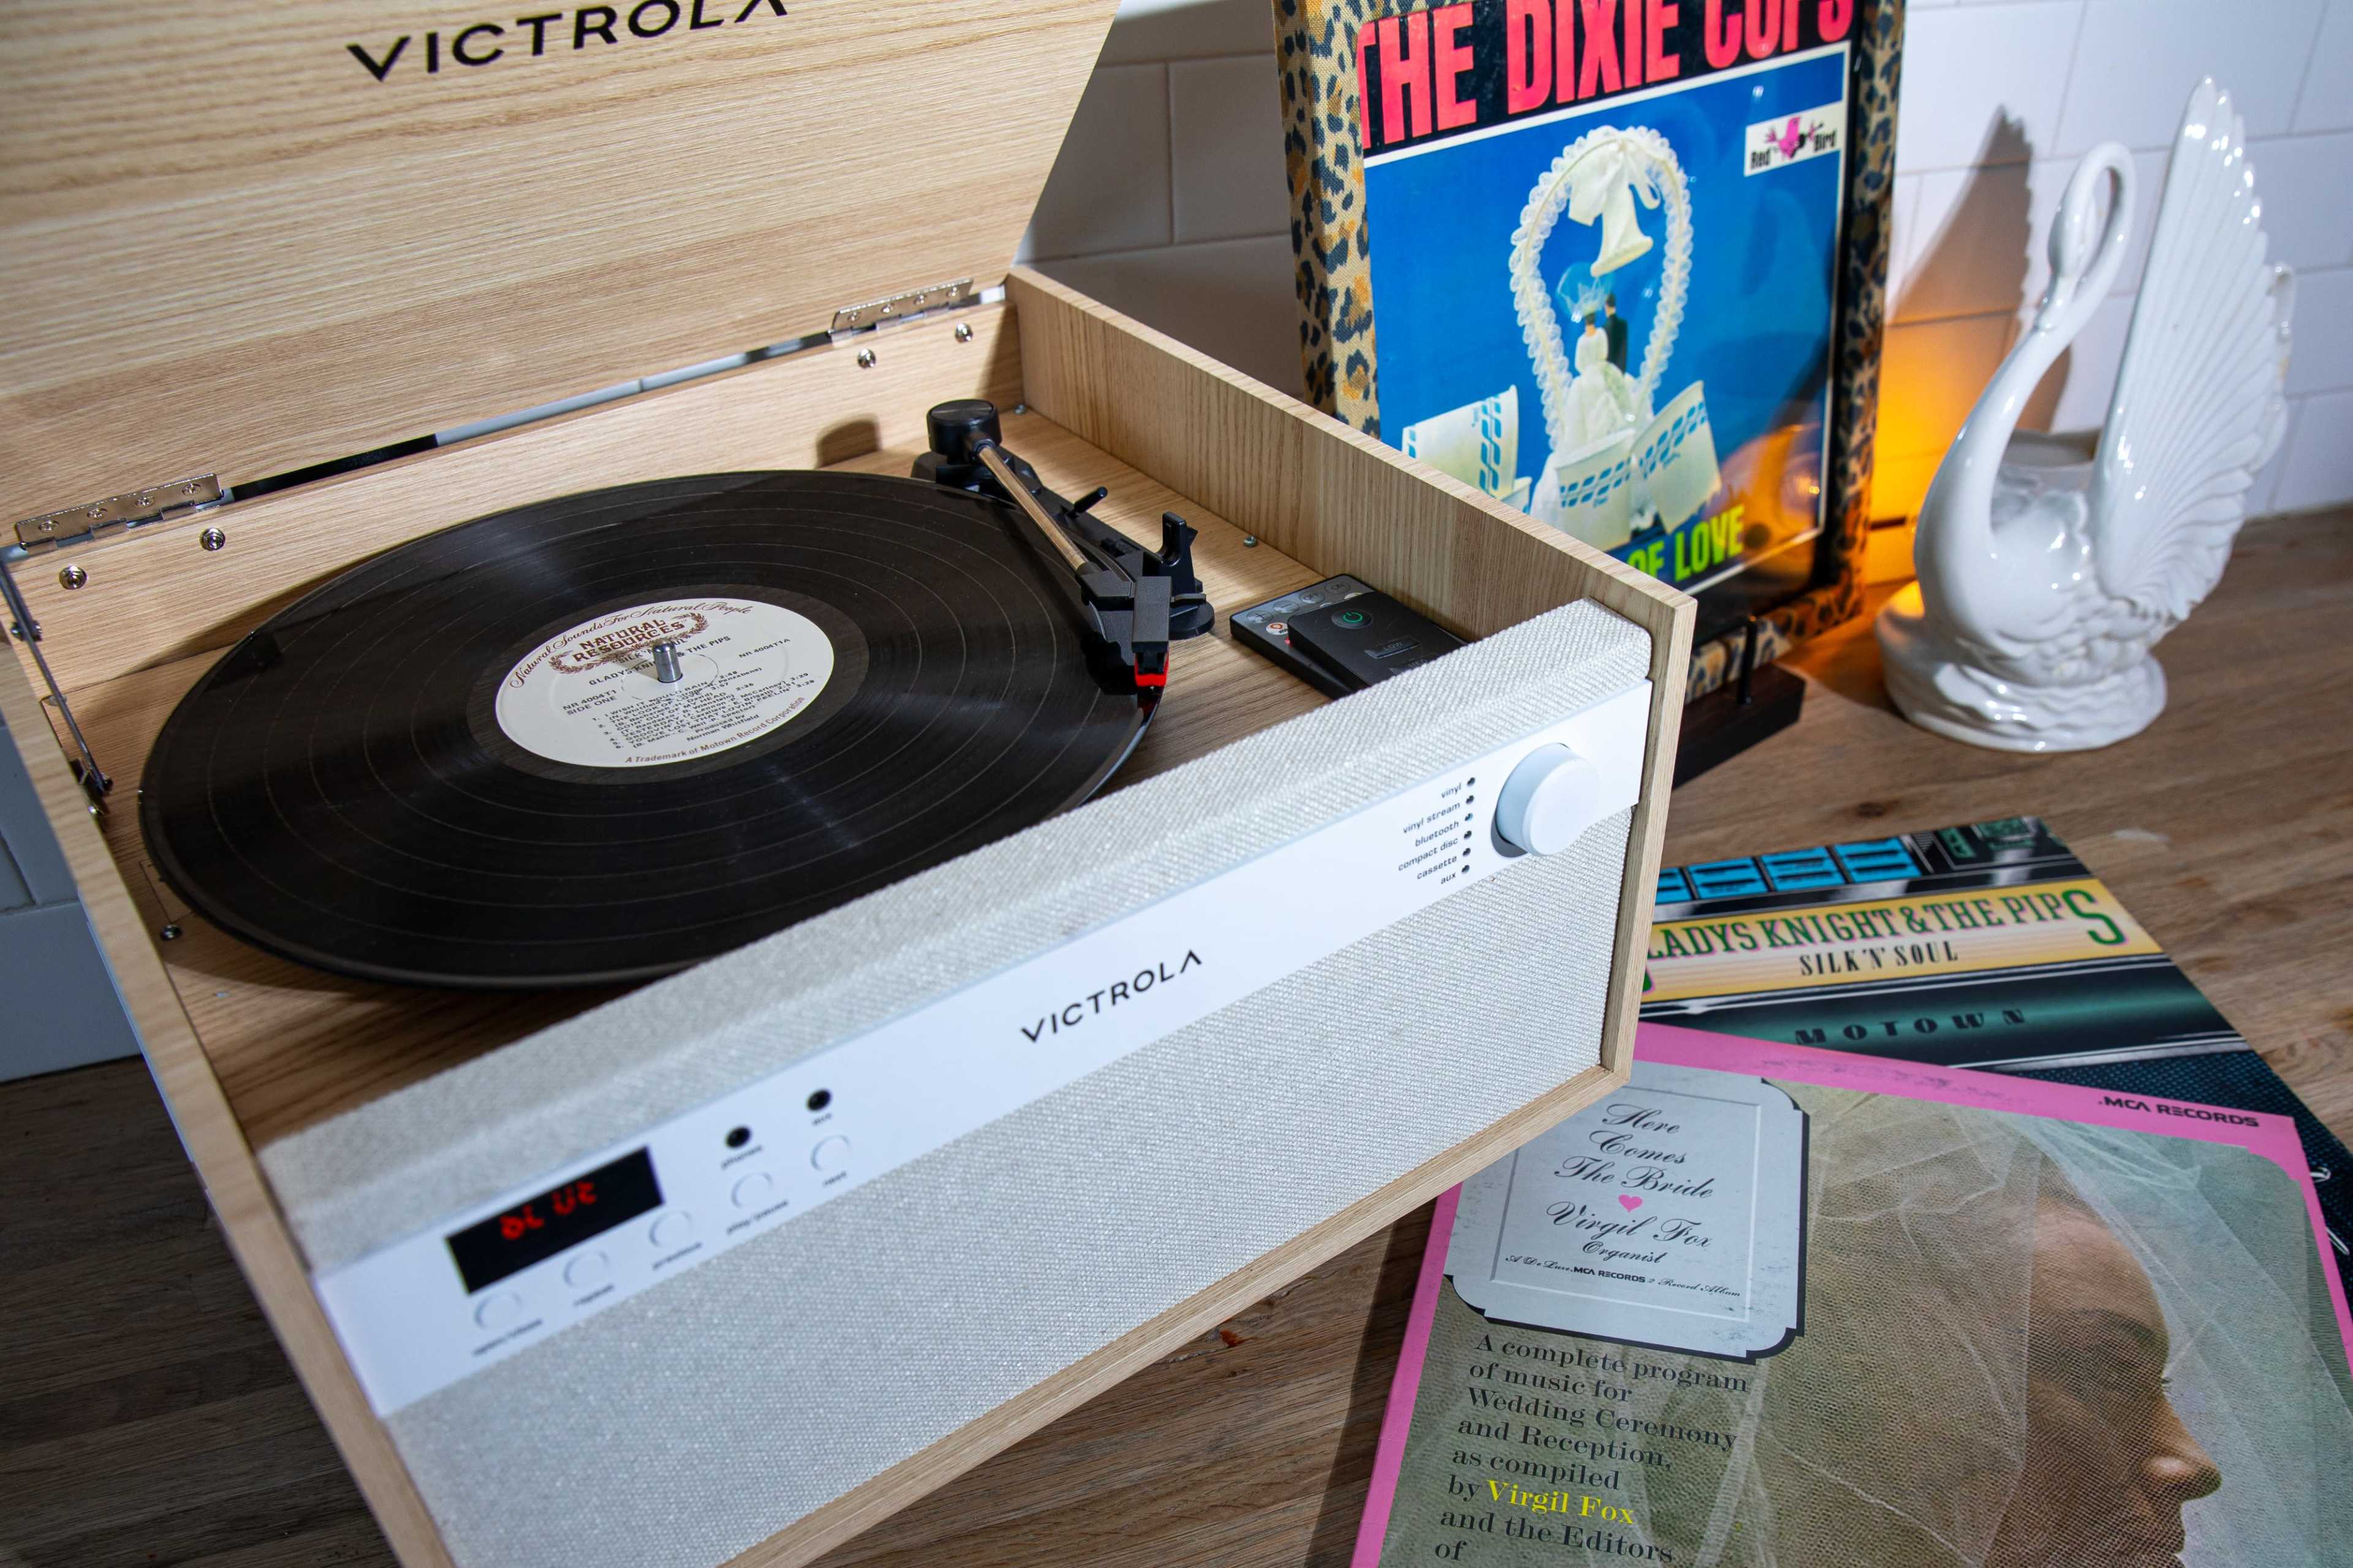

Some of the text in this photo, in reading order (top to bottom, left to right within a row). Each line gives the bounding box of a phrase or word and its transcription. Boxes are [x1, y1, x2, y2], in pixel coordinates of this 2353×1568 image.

[346, 0, 787, 82] VICTROLA
[1507, 0, 1681, 115] DIXIE
[1675, 504, 1745, 582] LOVE
[510, 602, 754, 688] Natural Sounds For Natural People
[572, 621, 686, 662] RESOURCES
[580, 619, 667, 651] NATURAL
[754, 638, 791, 653] 4004T1A
[588, 668, 633, 686] GLADYS
[634, 661, 656, 672] KNI
[688, 643, 708, 653] THE
[708, 635, 731, 646] PIPS
[567, 695, 618, 716] SIDE ONE
[580, 689, 618, 704] 4004T1
[611, 705, 634, 714] WISH
[649, 690, 681, 703] WOULD
[684, 681, 708, 691] RAIN
[632, 706, 657, 716] LOOK
[646, 712, 665, 721] OUT
[700, 692, 726, 703] HEAD
[623, 716, 680, 737] YESTERDAY
[696, 702, 725, 713] Lennon
[635, 750, 687, 763] Trademark
[689, 747, 699, 756] of
[700, 736, 737, 752] Motown
[737, 722, 767, 739] Record
[766, 696, 806, 724] Corporation
[668, 722, 692, 732] LOST
[694, 712, 719, 722] THAT
[686, 714, 759, 741] Norman Whitfield
[695, 718, 733, 733] Produced
[1441, 783, 1462, 798] vinyl
[1403, 802, 1461, 833] vinyl stream
[1415, 821, 1460, 847] bluetooth
[1398, 837, 1459, 871] compact disc
[1417, 855, 1458, 880] cassette
[1441, 873, 1457, 885] aux
[1646, 888, 2128, 961] LADYS KNIGHT & THE PIPS
[1799, 950, 1860, 976] SILK
[1893, 941, 1958, 967] SOUL
[1020, 949, 1202, 1043] VICTROLA
[1795, 1009, 2025, 1043] MOTOWN
[1601, 1103, 1681, 1135] Here
[2156, 1104, 2260, 1127] RECORDS
[1589, 1130, 1686, 1165] Comes
[1553, 1156, 1716, 1199] The Bride
[1546, 1201, 1714, 1249] Virgil Fox
[1582, 1240, 1667, 1265] Organist
[1598, 1270, 1646, 1284] RECORDS
[1658, 1278, 1702, 1290] Record
[1700, 1285, 1741, 1297] Album
[1475, 1334, 1749, 1394] A complete program
[1469, 1363, 1633, 1404] of music for
[1466, 1386, 1738, 1453] Wedding Ceremony
[1457, 1417, 1673, 1471] and Reception,
[1452, 1447, 1621, 1491] as compiled
[1447, 1474, 1636, 1526] by Virgil Fox
[1434, 1539, 1468, 1561] of
[1440, 1507, 1673, 1564] and the Editors
